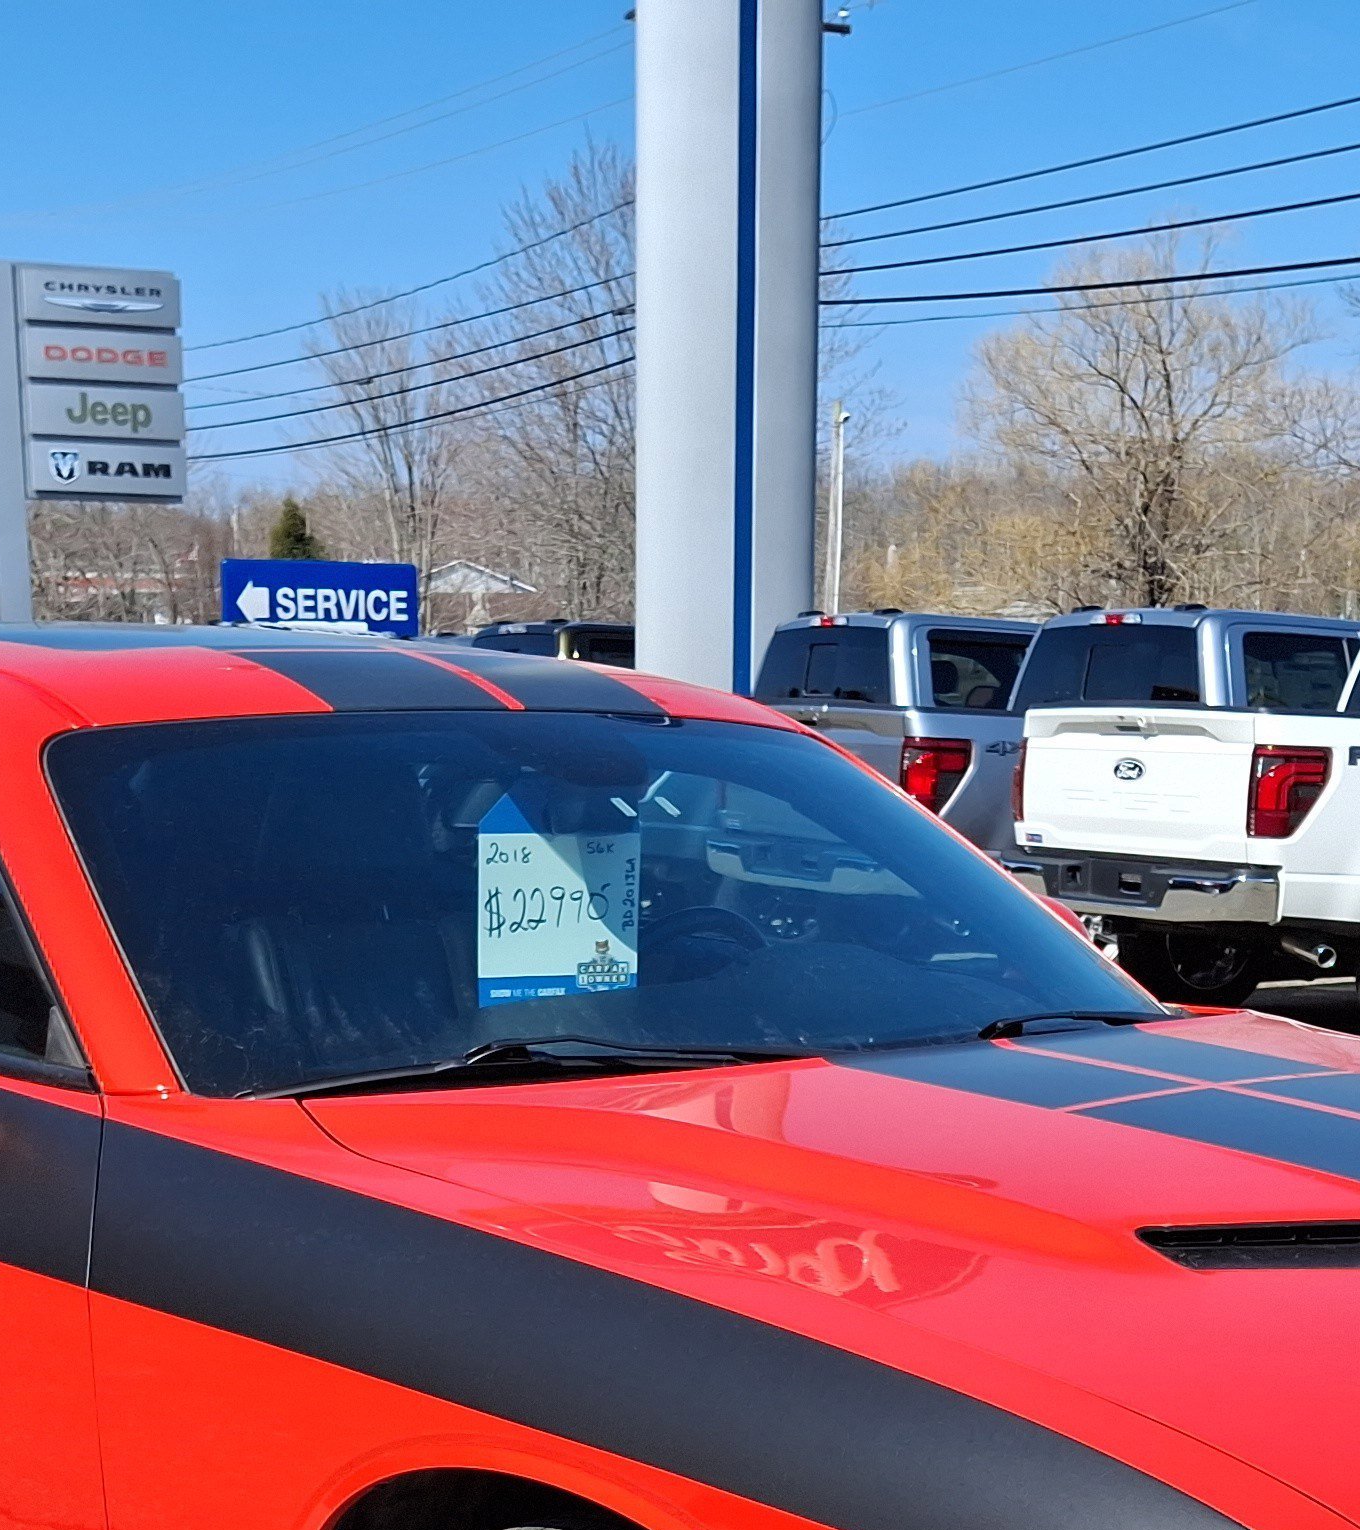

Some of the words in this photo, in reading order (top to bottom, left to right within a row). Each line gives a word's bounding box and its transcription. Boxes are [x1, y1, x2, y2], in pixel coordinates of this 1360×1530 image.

[43, 281, 162, 297] CHRYSLER
[43, 345, 169, 368] DODGE
[66, 391, 153, 433] Jeep
[87, 460, 173, 479] RAM
[275, 586, 409, 621] SERVICE
[485, 842, 532, 865] 2018
